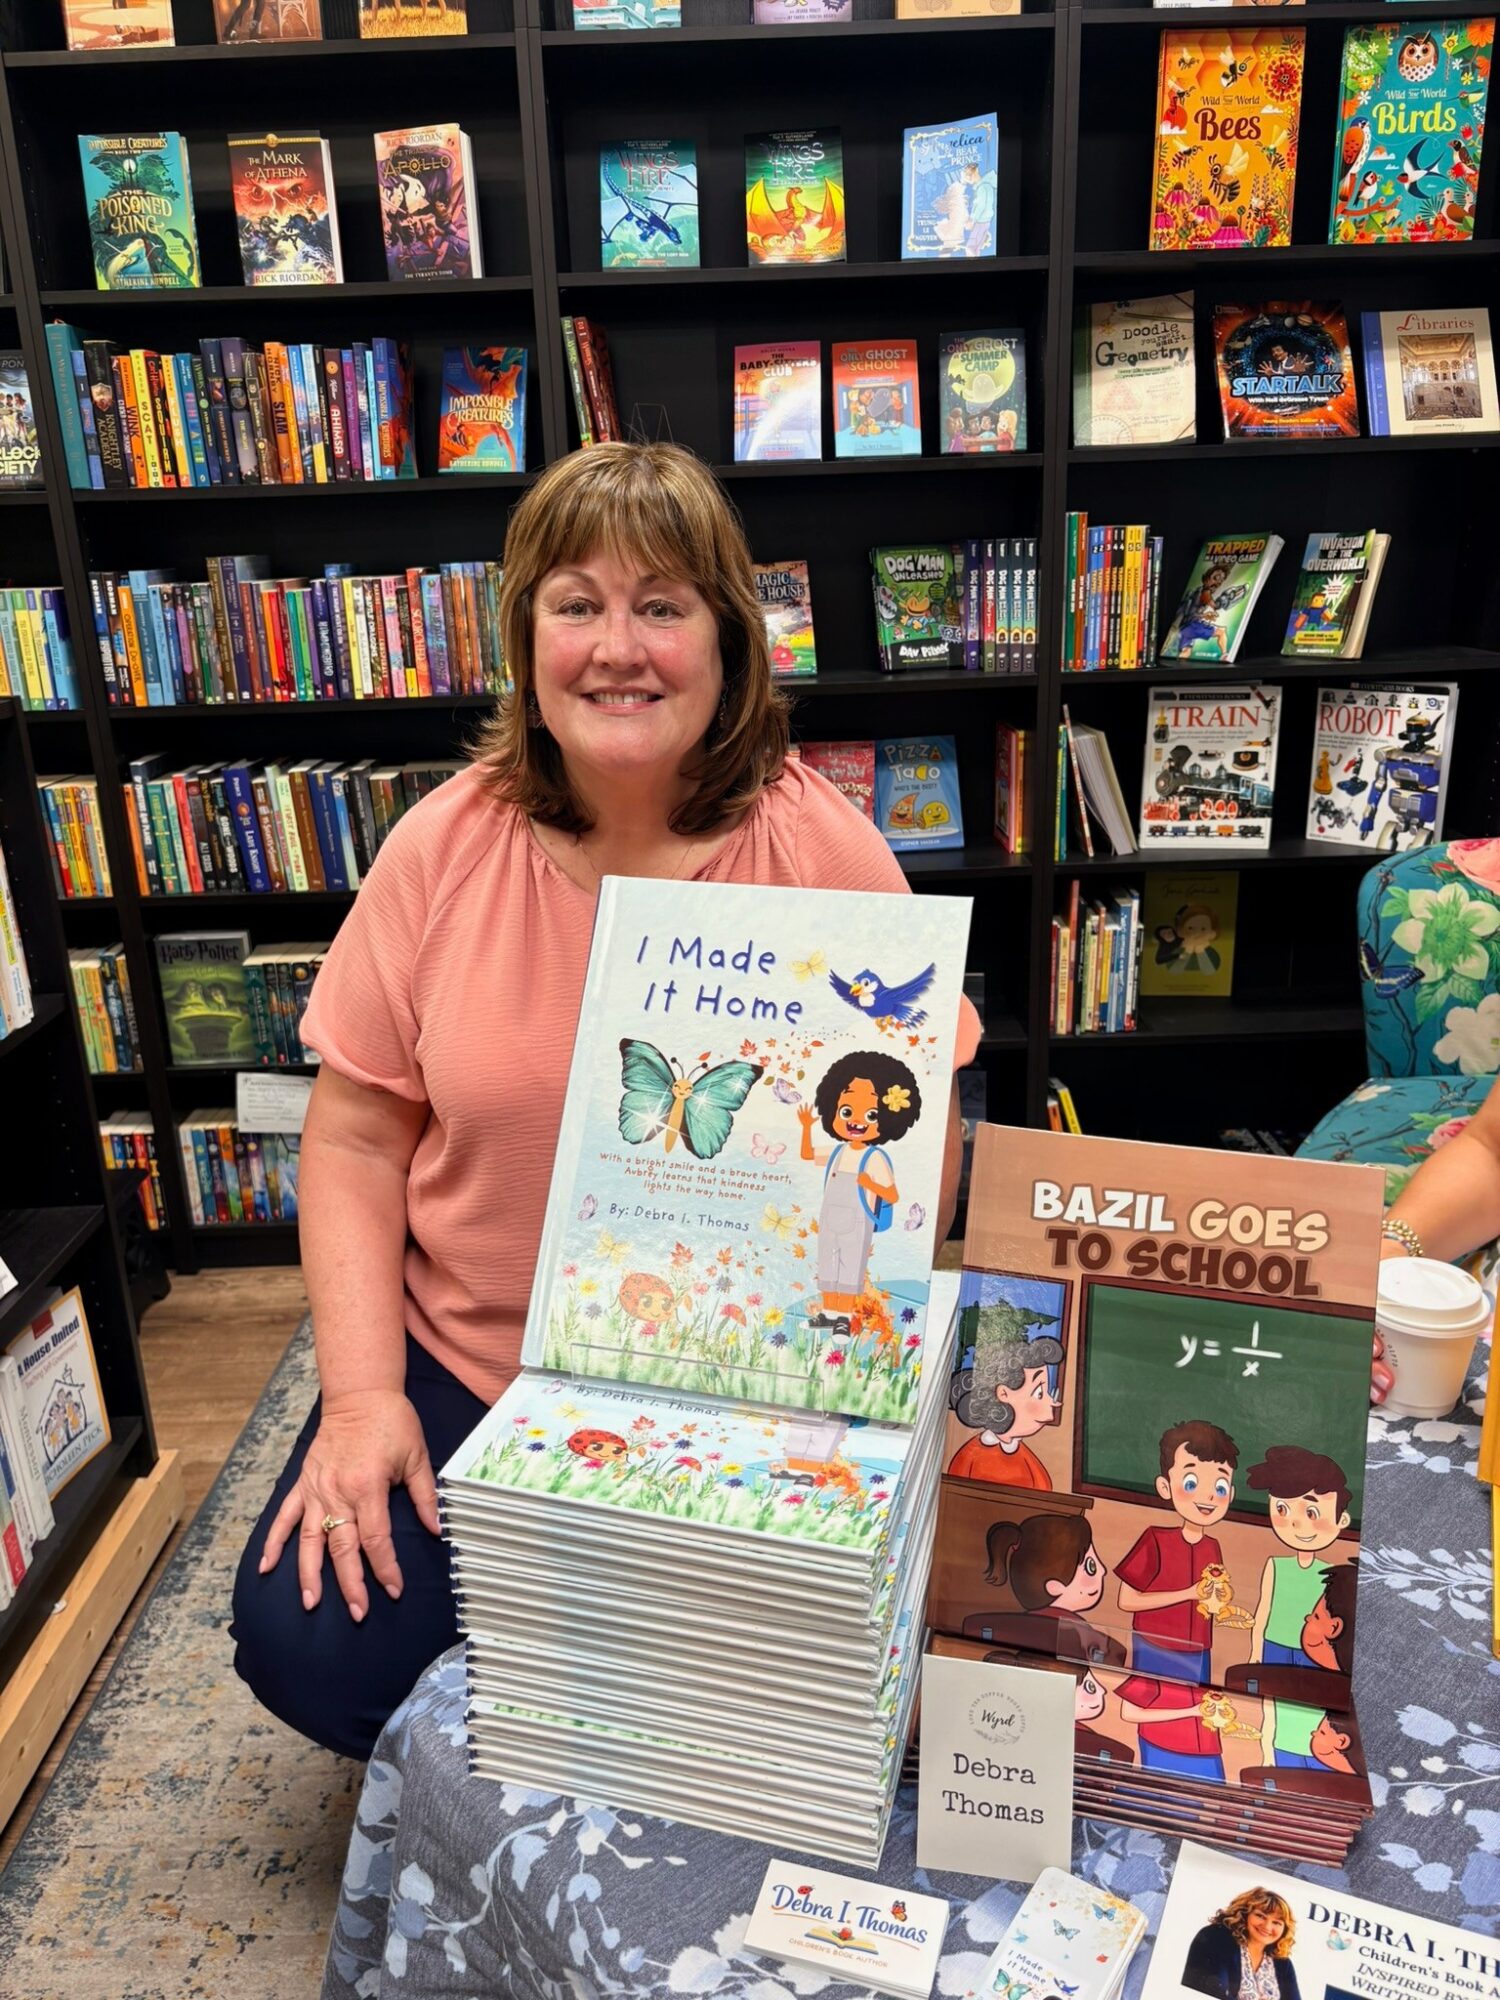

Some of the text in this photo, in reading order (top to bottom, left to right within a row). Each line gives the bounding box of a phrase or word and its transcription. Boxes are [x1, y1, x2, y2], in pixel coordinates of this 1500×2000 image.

[1201, 96, 1260, 106] Wild World
[1385, 88, 1447, 100] Wild World
[1194, 107, 1261, 141] Bees
[1372, 101, 1457, 135] Birds
[405, 132, 443, 146] RIORDAN
[247, 150, 304, 166] THE MARK
[618, 152, 679, 168] WINGS
[764, 142, 825, 163] WINGS
[256, 166, 308, 182] ATHENA
[383, 155, 451, 179] APOLLO
[625, 166, 671, 186] FIRE
[772, 160, 817, 180] FIRE
[100, 195, 172, 219] POISONED
[111, 215, 164, 237] KING
[255, 272, 323, 283] RICK RIORDAN
[1122, 322, 1179, 341] Doodle
[1396, 313, 1474, 331] Libraries
[975, 338, 1018, 351] GHOST
[1156, 334, 1186, 347] smart
[849, 361, 900, 371] SCHOOL
[865, 349, 908, 360] GHOST
[960, 350, 1008, 363] SUMMER
[1095, 341, 1189, 367] Geometry
[763, 366, 793, 377] CLUB
[965, 361, 1000, 372] CAMP
[1232, 374, 1342, 396] STARTALK
[377, 380, 388, 420] IMPOSSIBLE
[450, 394, 513, 412] IMPOSSIBLE
[127, 406, 140, 437] WINK
[142, 401, 153, 445] SCAT
[274, 402, 288, 434] SLAM
[447, 408, 514, 429] CREATURES
[96, 418, 113, 466] ACADEMY
[105, 414, 122, 470] KNIGHTLEY
[153, 397, 173, 473] SQUIRM
[331, 408, 344, 455] AHIMSA
[1207, 540, 1265, 555] TRAPPED
[1320, 535, 1365, 551] INVASION
[1340, 550, 1353, 558] THE
[884, 554, 944, 574] DOG MAN
[1213, 553, 1260, 563] VIDEO GAME
[1306, 557, 1366, 571] OVERWORLD
[893, 571, 944, 581] UNLEASHED
[91, 579, 102, 615] KORMAN
[106, 581, 117, 615] KORMAN
[767, 584, 805, 600] HOUSE
[123, 613, 135, 649] OPERATION
[413, 609, 426, 662] SCORCHED
[318, 621, 334, 676] HUMMINGBIRD
[899, 646, 920, 658] DAV
[100, 640, 116, 682] HYPNOTISTS
[1167, 705, 1261, 728] TRAIN
[1319, 704, 1401, 737] ROBOT
[220, 816, 238, 873] GONE WOODS
[249, 848, 261, 874] KNIGHT
[161, 940, 239, 965] Harry Potter
[637, 935, 777, 976] I Made
[644, 980, 804, 1025] It Home
[600, 1152, 622, 1163] With
[635, 1158, 666, 1173] bright
[669, 1161, 694, 1172] smile
[698, 1165, 716, 1174] and
[730, 1168, 758, 1180] brave
[762, 1172, 792, 1185] heart,
[624, 1166, 766, 1192] Aubrey learns that kindness
[643, 1180, 747, 1201] lights the way home.
[609, 1203, 750, 1232] By: Debra I. Thomas
[1033, 1180, 1329, 1252] BAZIL GOES
[1047, 1228, 1320, 1296] TO SCHOOL
[17, 1315, 80, 1378] A House United
[1242, 1360, 1260, 1377] x
[575, 1384, 598, 1398] By:
[600, 1390, 644, 1405] Debra
[667, 1400, 721, 1417] Thomas
[19, 1405, 42, 1481] Montessori
[981, 1709, 1015, 1729] Wyrd
[953, 1752, 1036, 1785] Debra
[942, 1790, 1044, 1825] Thomas
[772, 1884, 928, 1944] Debra I. Thomas
[1307, 1901, 1416, 1953] DEBRA
[1426, 1939, 1445, 1961] I.
[788, 1937, 888, 1969] CHILDREN'S BOOK AUTHOR
[1016, 1953, 1043, 1972] Made
[1006, 1960, 1046, 1984] It Home
[1356, 1962, 1440, 1997] INSPIRED
[1359, 1945, 1439, 1980] Children's
[1445, 1972, 1484, 1993] Book
